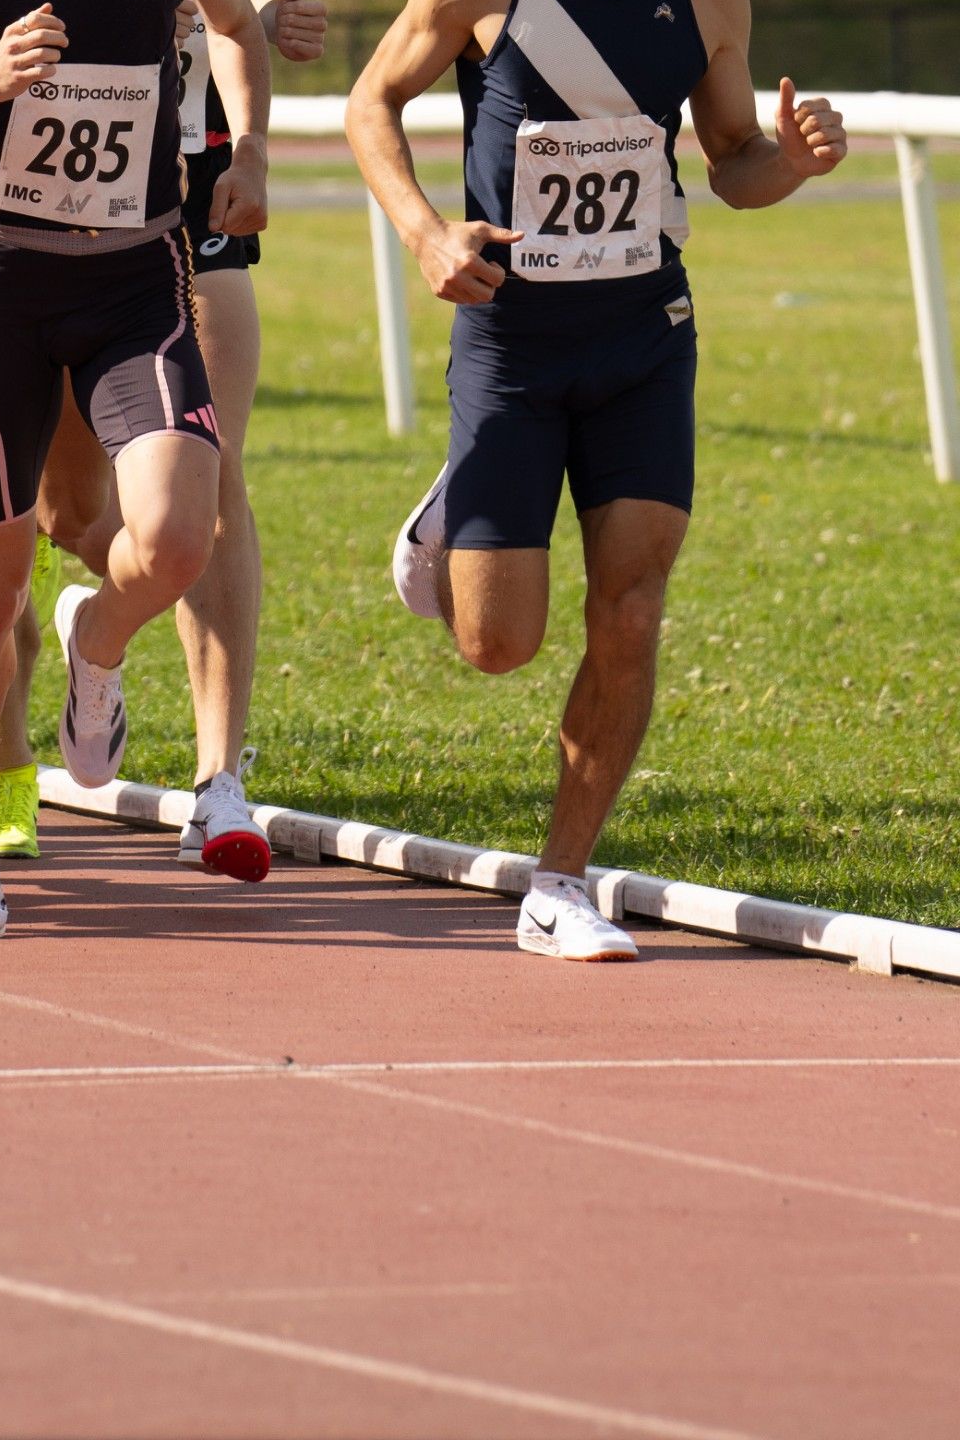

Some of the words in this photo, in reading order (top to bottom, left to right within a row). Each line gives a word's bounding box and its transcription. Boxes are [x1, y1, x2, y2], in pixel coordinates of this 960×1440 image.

[61, 84, 151, 102] Tripadvisor
[24, 117, 134, 183] 285
[562, 136, 655, 157] Tripadvisor
[3, 183, 43, 204] IMC
[537, 169, 640, 236] 282
[520, 252, 560, 268] IMC
